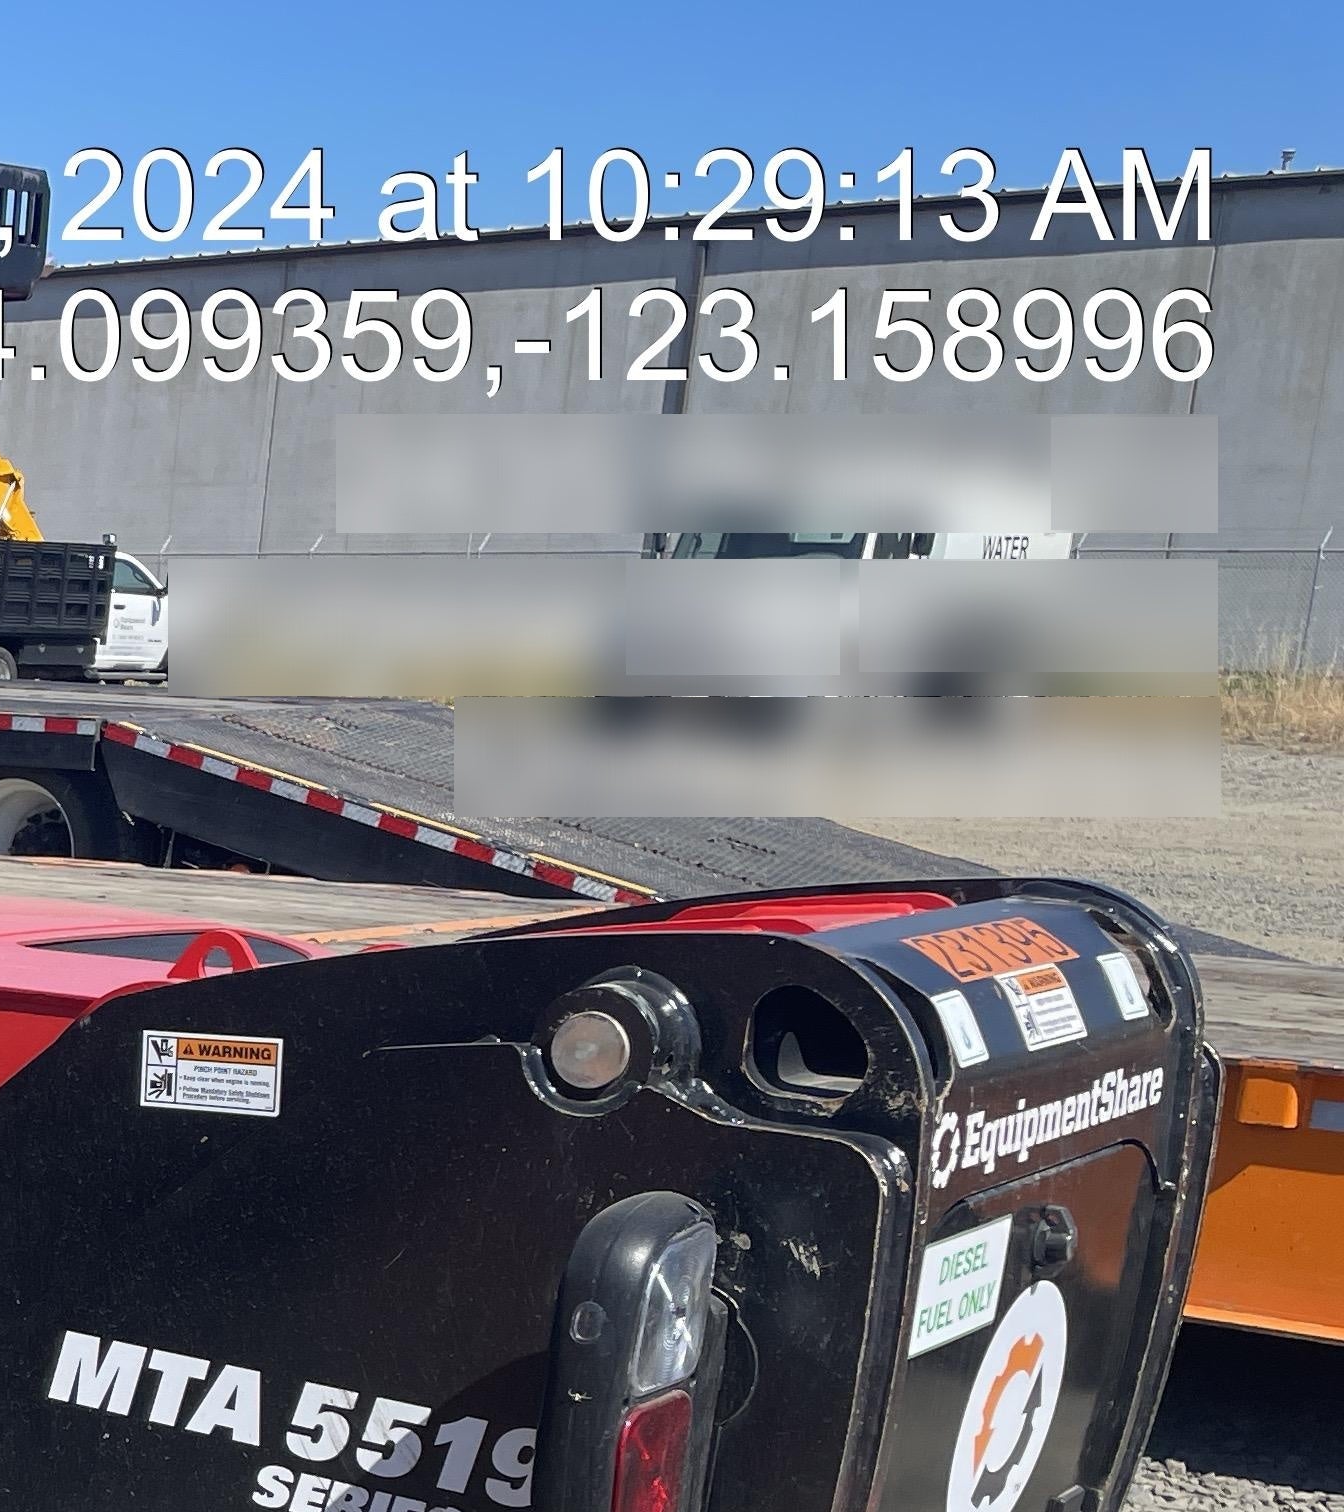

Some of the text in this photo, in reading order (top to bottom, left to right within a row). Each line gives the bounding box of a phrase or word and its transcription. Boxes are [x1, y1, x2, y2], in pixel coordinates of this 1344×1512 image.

[982, 535, 1030, 559] WATER
[198, 1044, 272, 1061] WARNING
[961, 1066, 1165, 1175] EquipmentShare
[938, 1240, 990, 1286] DIESEL
[916, 1280, 998, 1339] FUEL ONLY
[47, 1330, 538, 1508] MTA 5519
